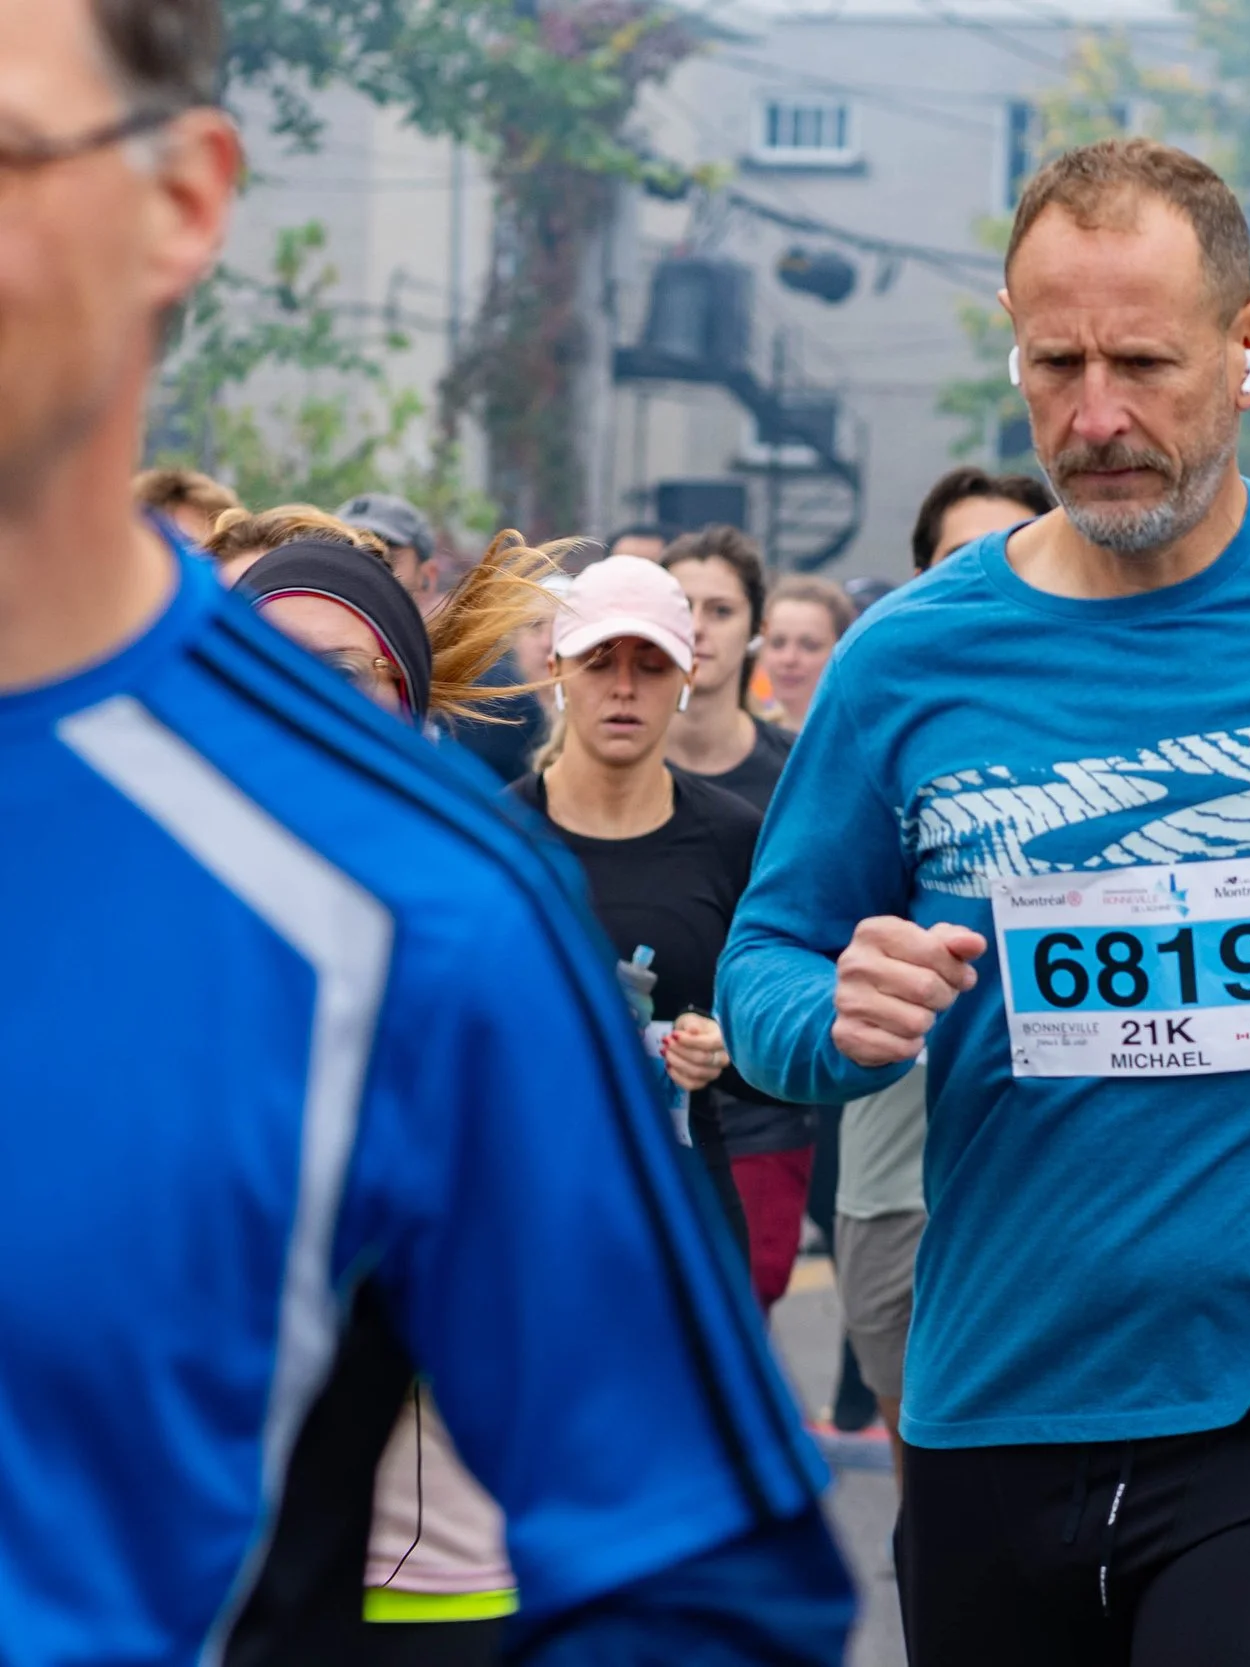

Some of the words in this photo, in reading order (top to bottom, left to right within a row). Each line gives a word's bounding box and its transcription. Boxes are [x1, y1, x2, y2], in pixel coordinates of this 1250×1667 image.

[1011, 894, 1066, 908] Montréal
[1022, 1022, 1100, 1035] BONNEVILLE
[1121, 1017, 1196, 1046] 21K
[1111, 1050, 1212, 1069] MICHAEL
